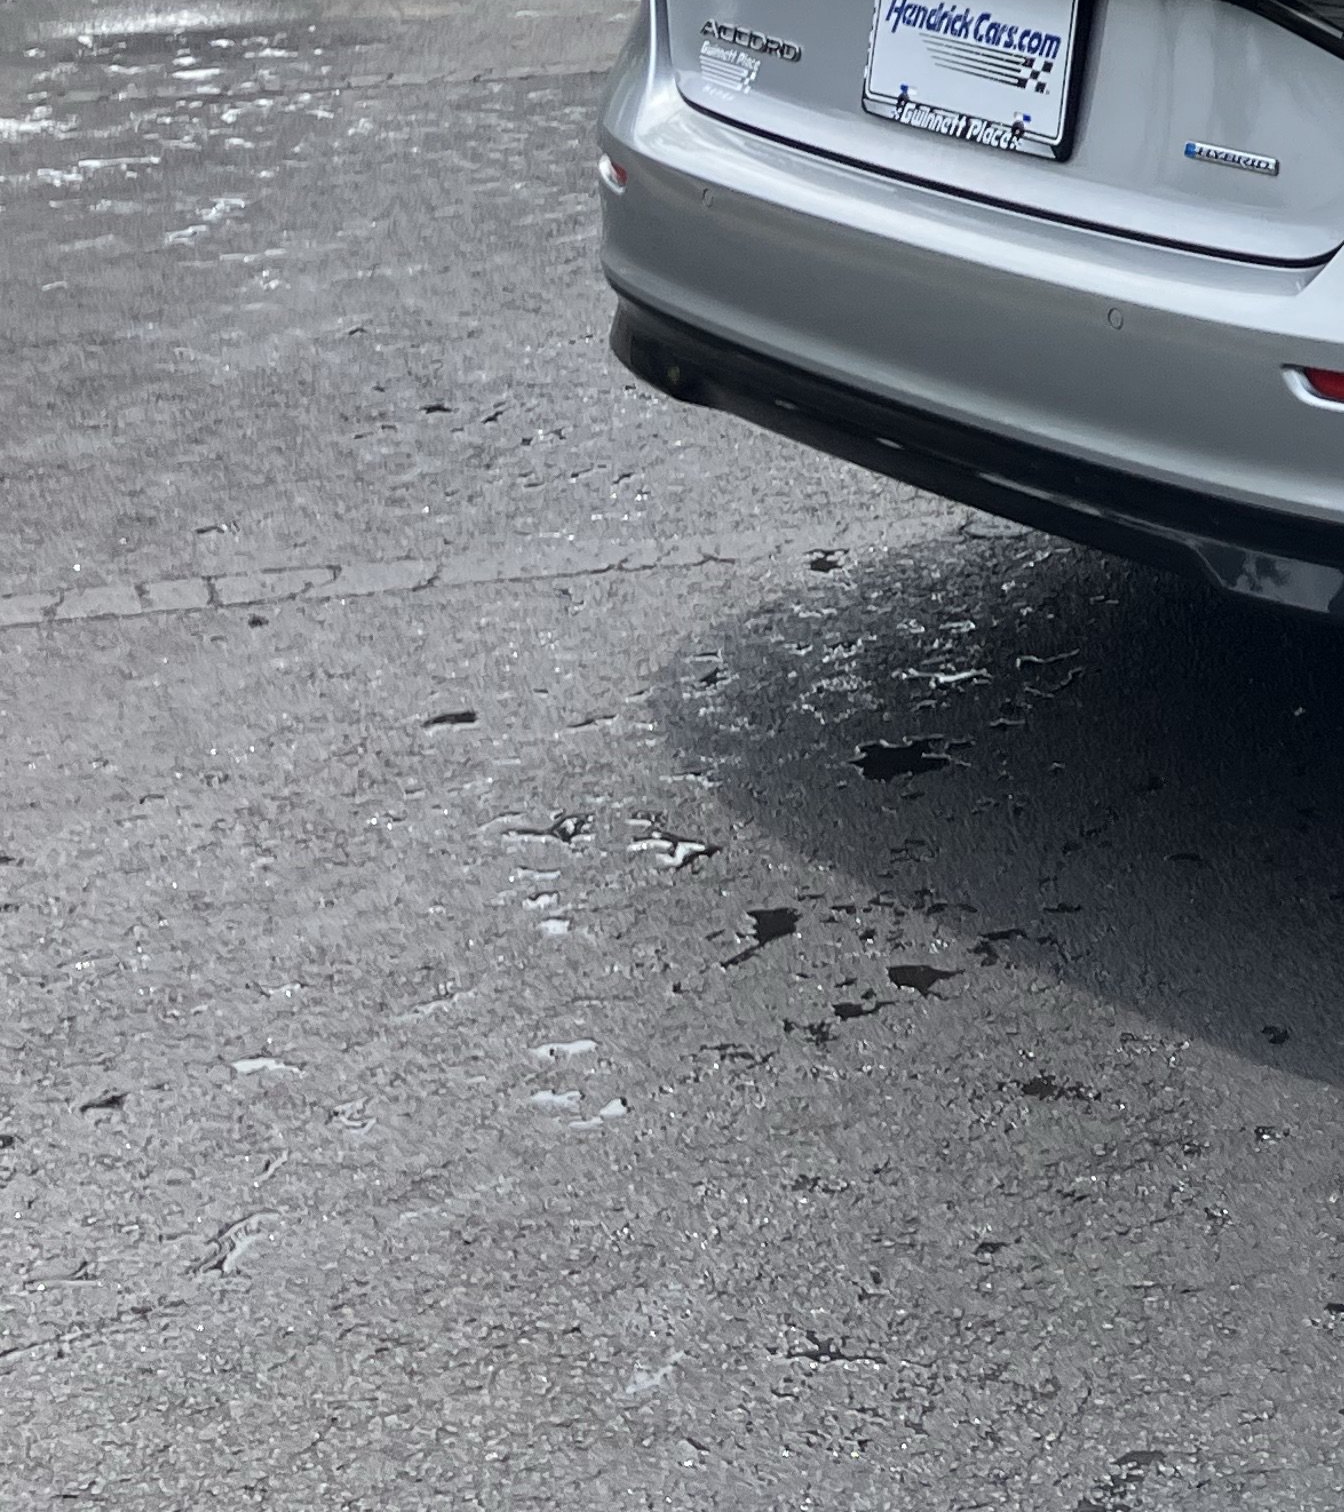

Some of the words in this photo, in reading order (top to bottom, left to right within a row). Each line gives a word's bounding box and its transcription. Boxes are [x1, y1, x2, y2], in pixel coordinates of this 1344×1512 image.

[699, 18, 803, 63] ACCORD
[900, 102, 967, 138] Gwinnett
[966, 118, 1013, 149] Place
[1197, 146, 1271, 170] HYBRID
